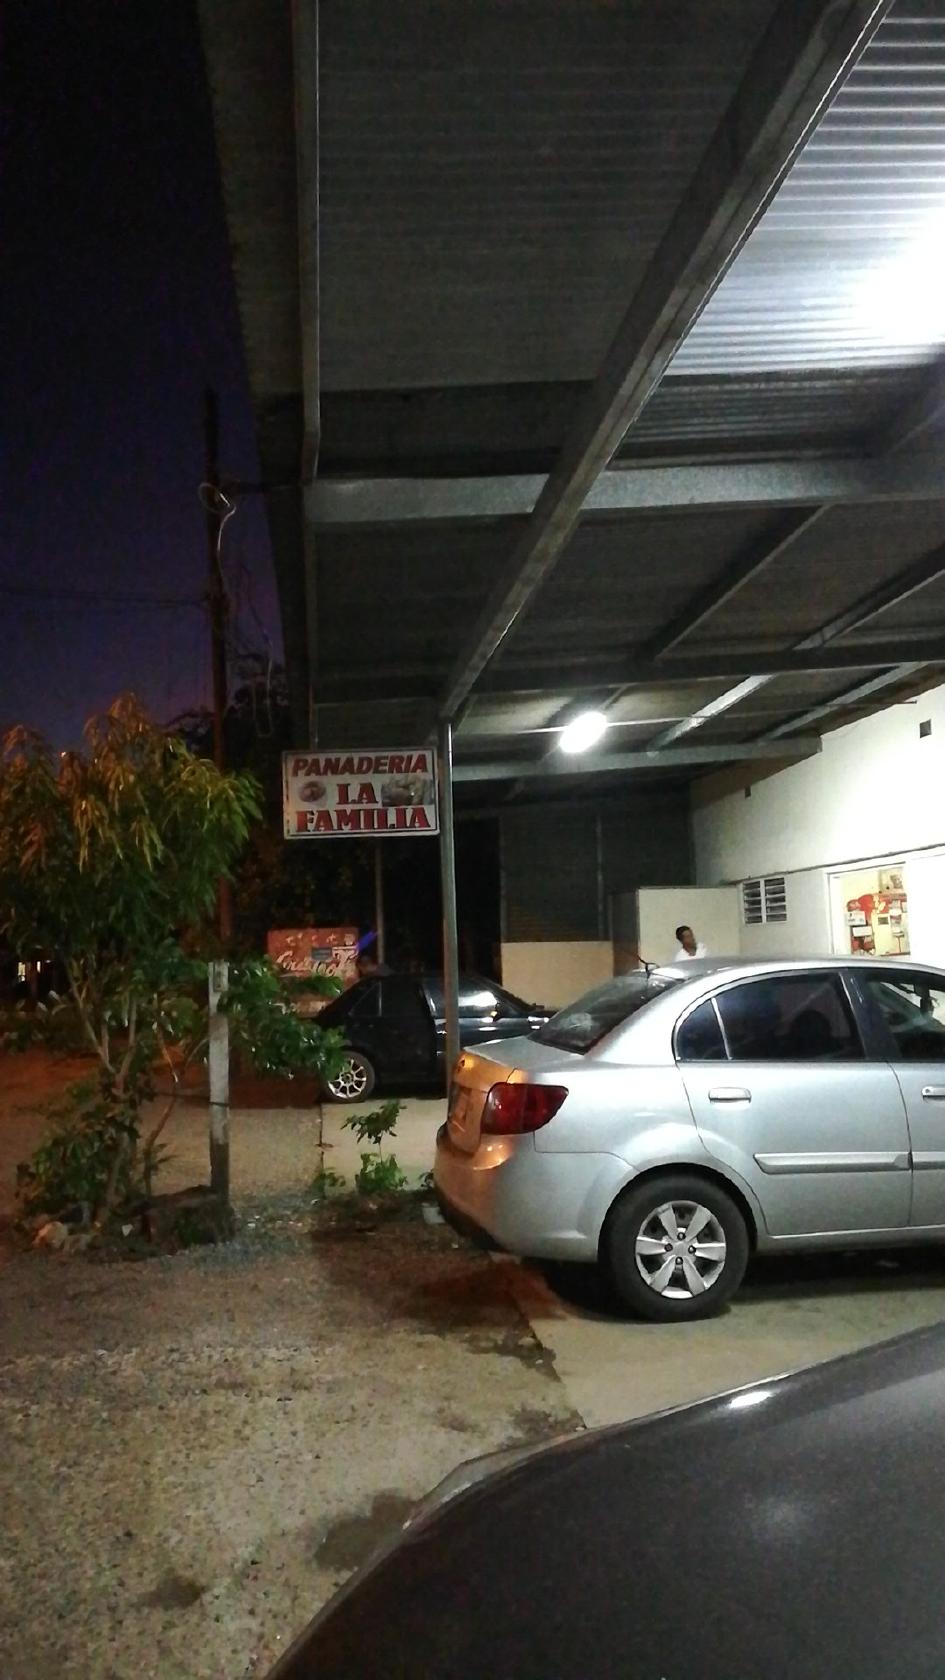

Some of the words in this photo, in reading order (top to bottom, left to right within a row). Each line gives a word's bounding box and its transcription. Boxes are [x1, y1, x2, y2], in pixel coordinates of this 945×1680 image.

[292, 754, 428, 777] PANADERIA
[336, 782, 378, 805] LA
[296, 807, 431, 832] FAMILIA
